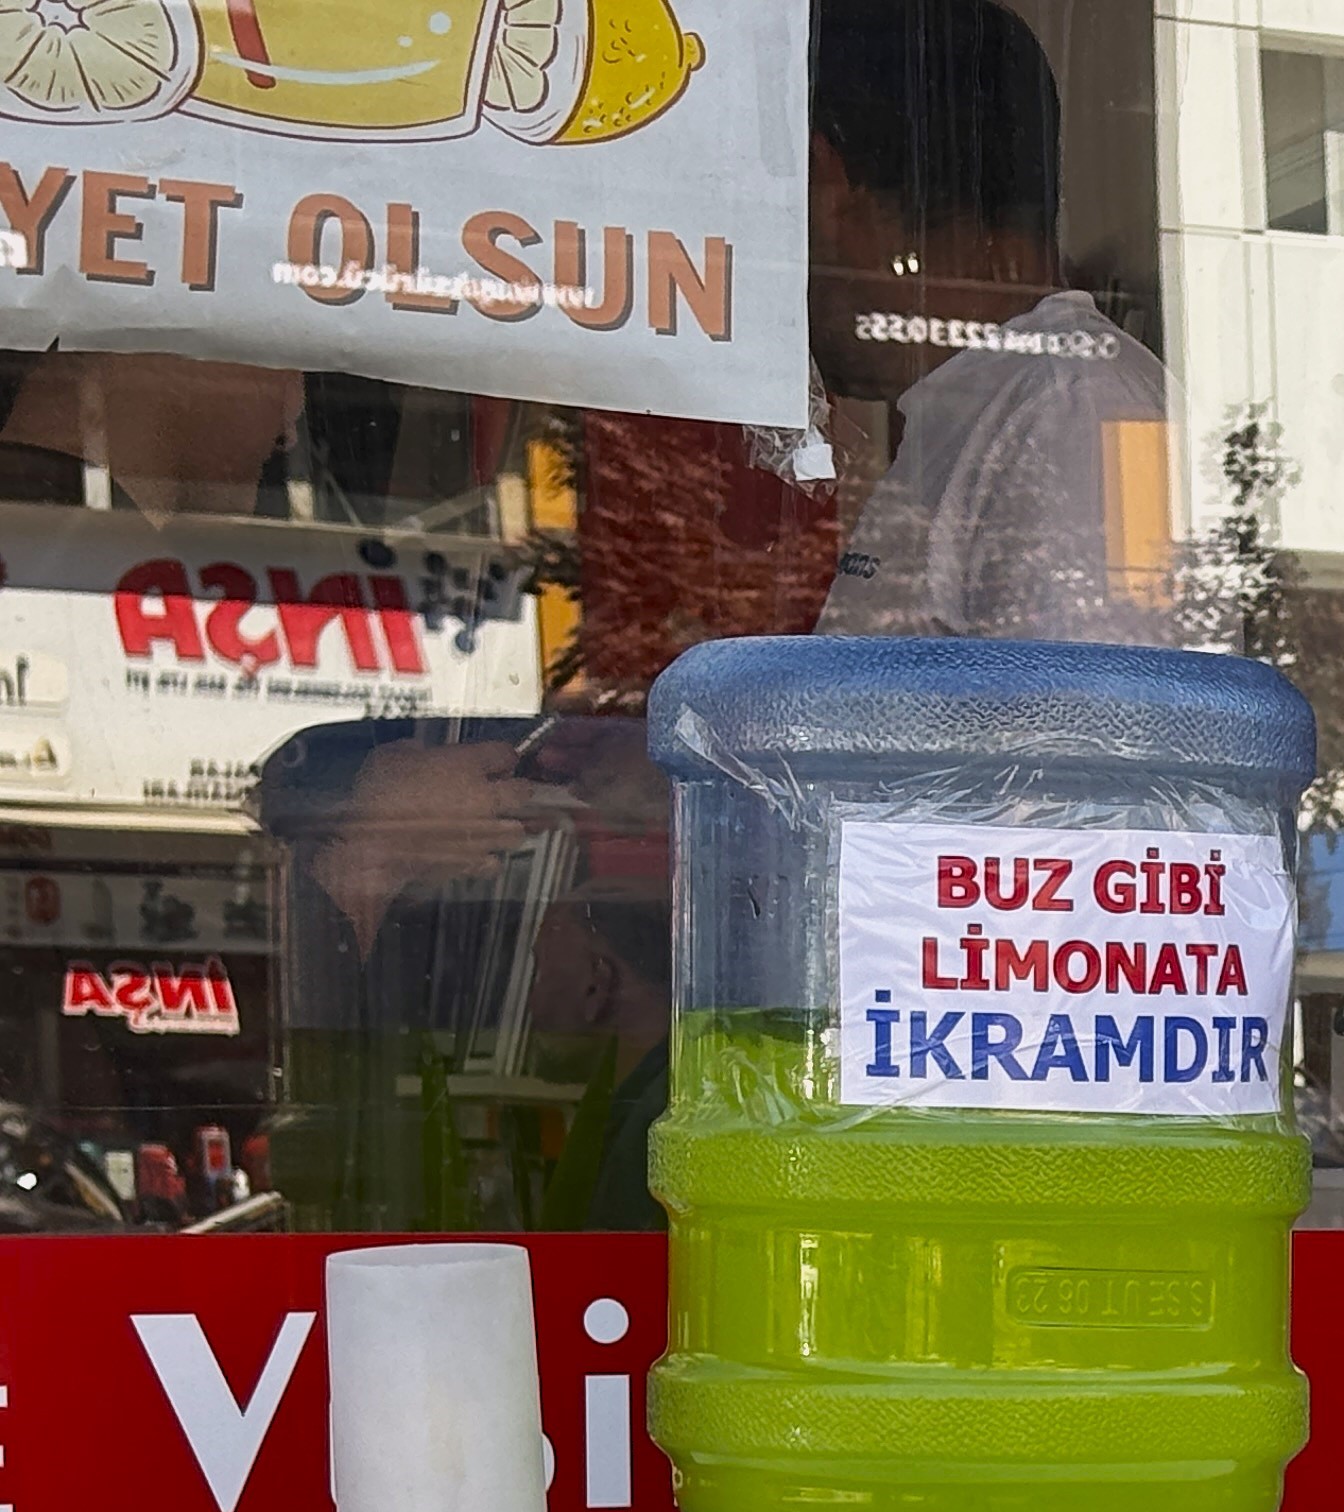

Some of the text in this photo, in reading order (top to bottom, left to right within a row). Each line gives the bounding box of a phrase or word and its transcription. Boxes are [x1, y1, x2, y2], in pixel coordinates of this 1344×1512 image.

[287, 192, 734, 344] OLSUN
[936, 846, 1227, 917] BUZ GİBİ
[920, 922, 1249, 997] LİMONATA
[864, 988, 1270, 1085] İKRAMDIR
